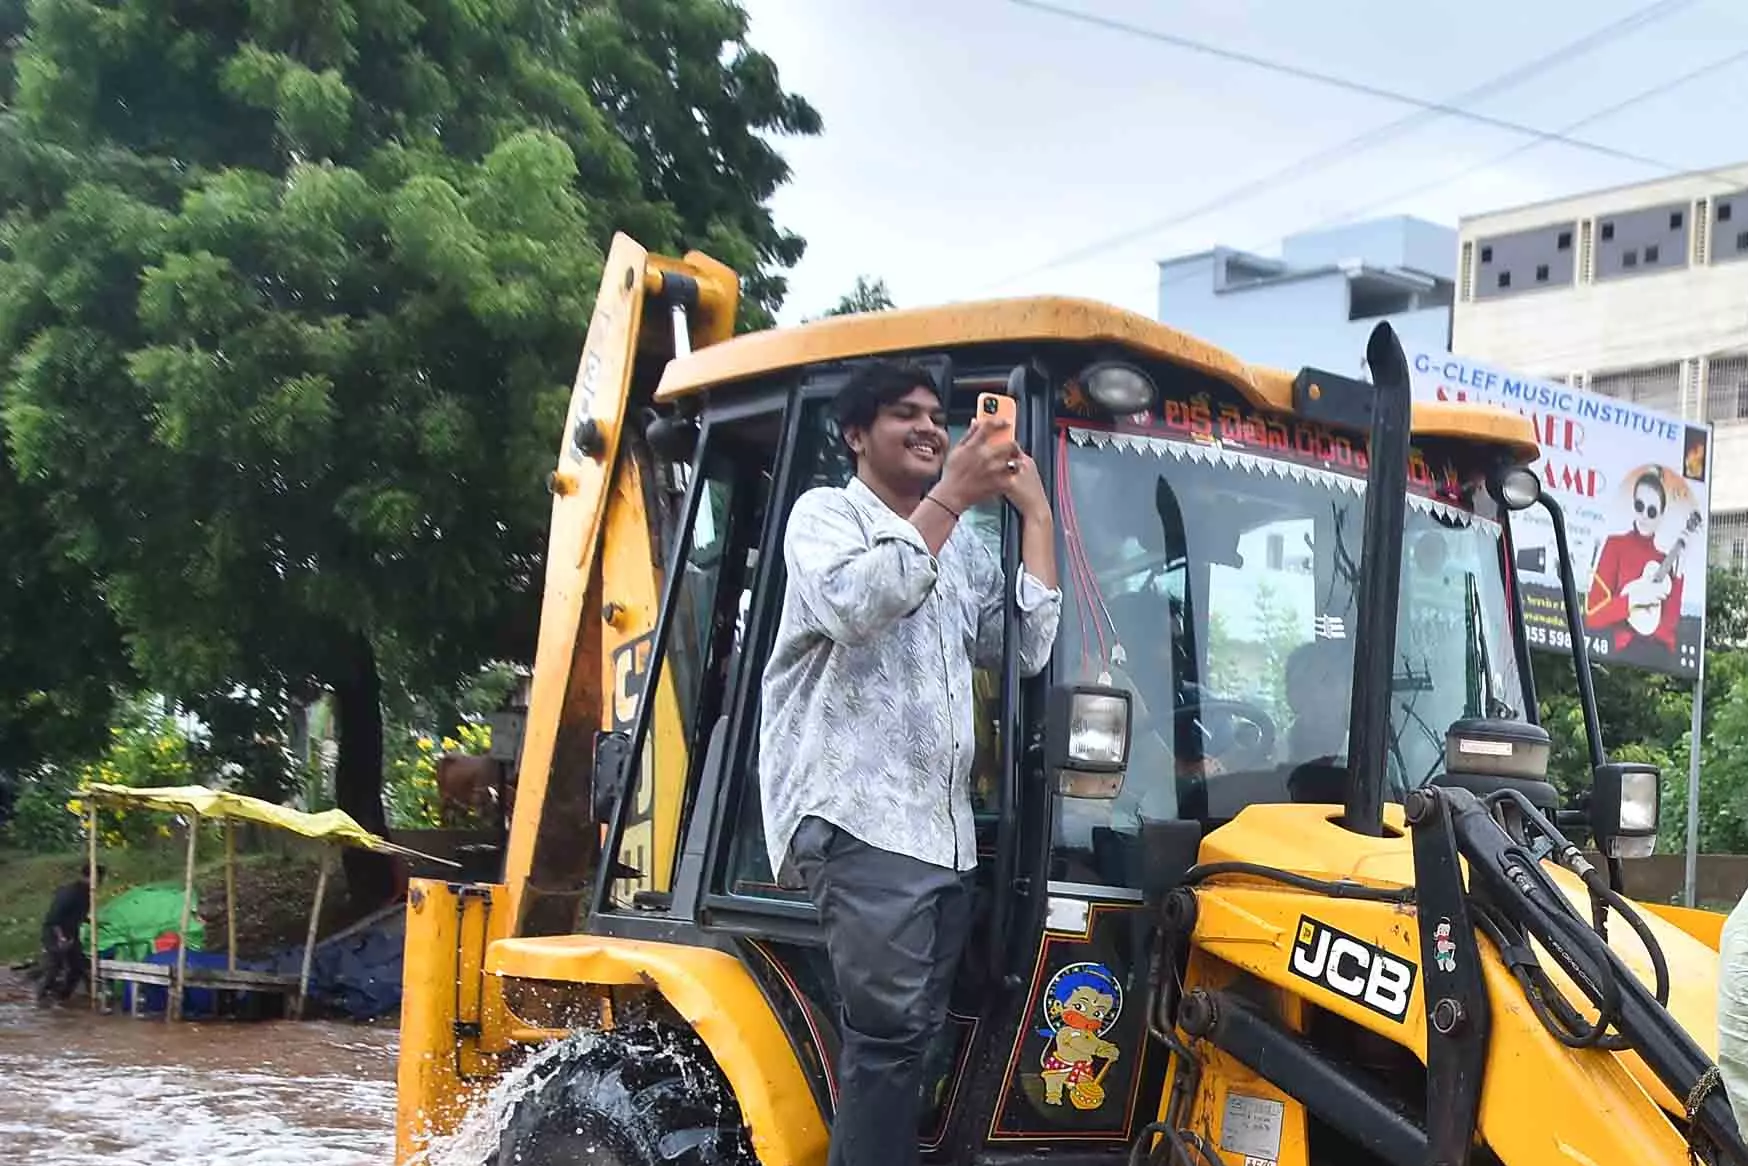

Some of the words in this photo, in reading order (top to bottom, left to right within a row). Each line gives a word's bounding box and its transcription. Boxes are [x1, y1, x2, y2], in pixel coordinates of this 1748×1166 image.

[1415, 354, 1497, 390] G-CLEF
[1502, 378, 1573, 412] MUSIC
[1577, 399, 1680, 442] INSTITUTE
[1541, 458, 1609, 498] AMP
[1293, 928, 1411, 1015] JCB
